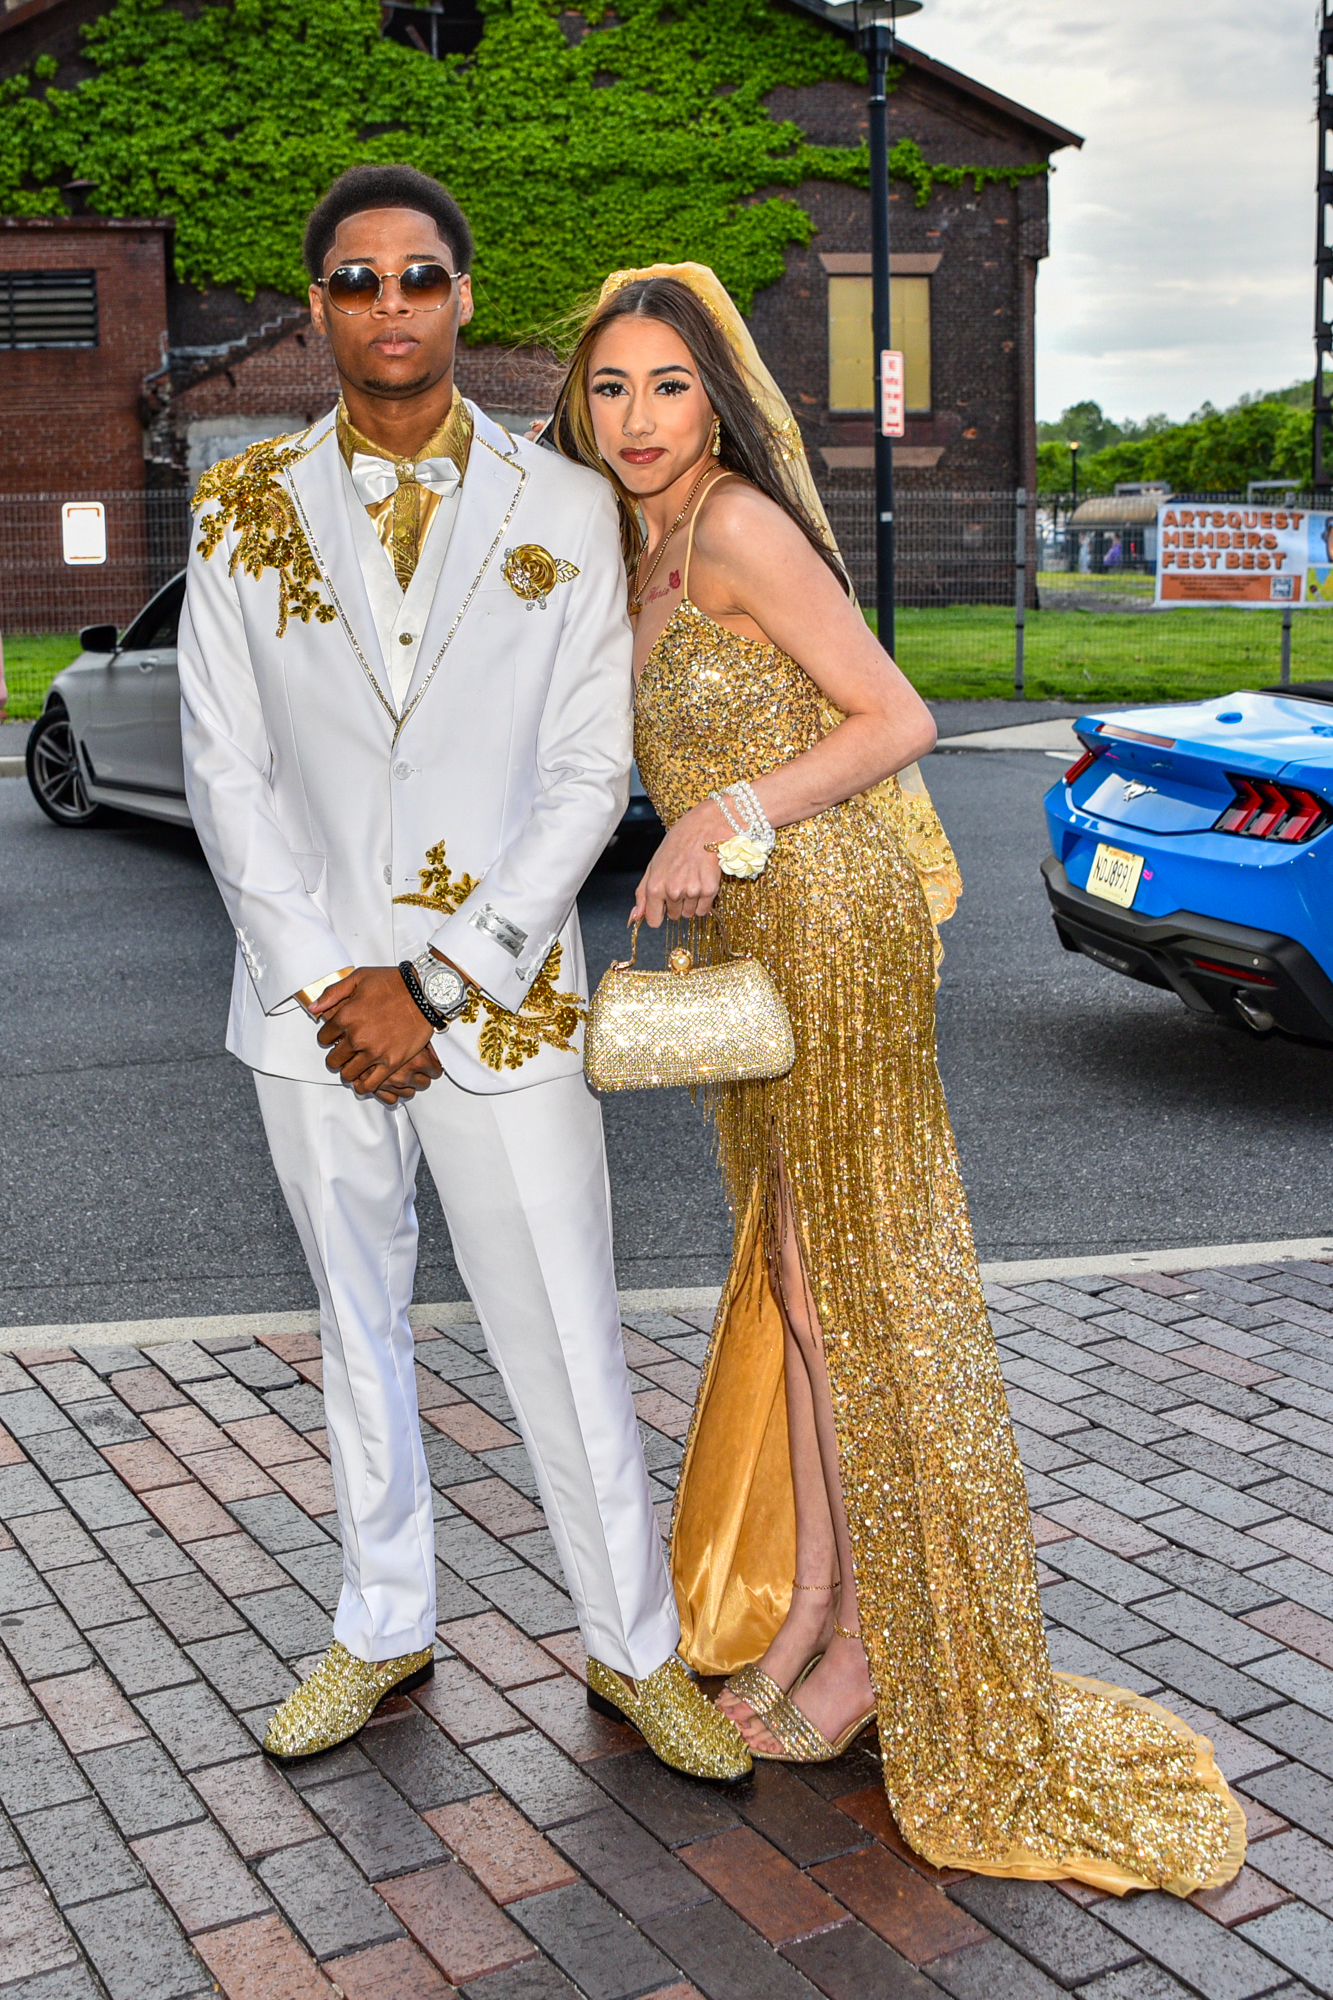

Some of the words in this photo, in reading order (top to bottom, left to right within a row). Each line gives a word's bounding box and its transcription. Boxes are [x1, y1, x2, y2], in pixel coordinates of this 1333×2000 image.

[1163, 510, 1304, 530] ARTSQUEST
[1163, 531, 1278, 549] MEMBERS
[1162, 552, 1220, 569] FEST
[1225, 552, 1287, 570] BEST
